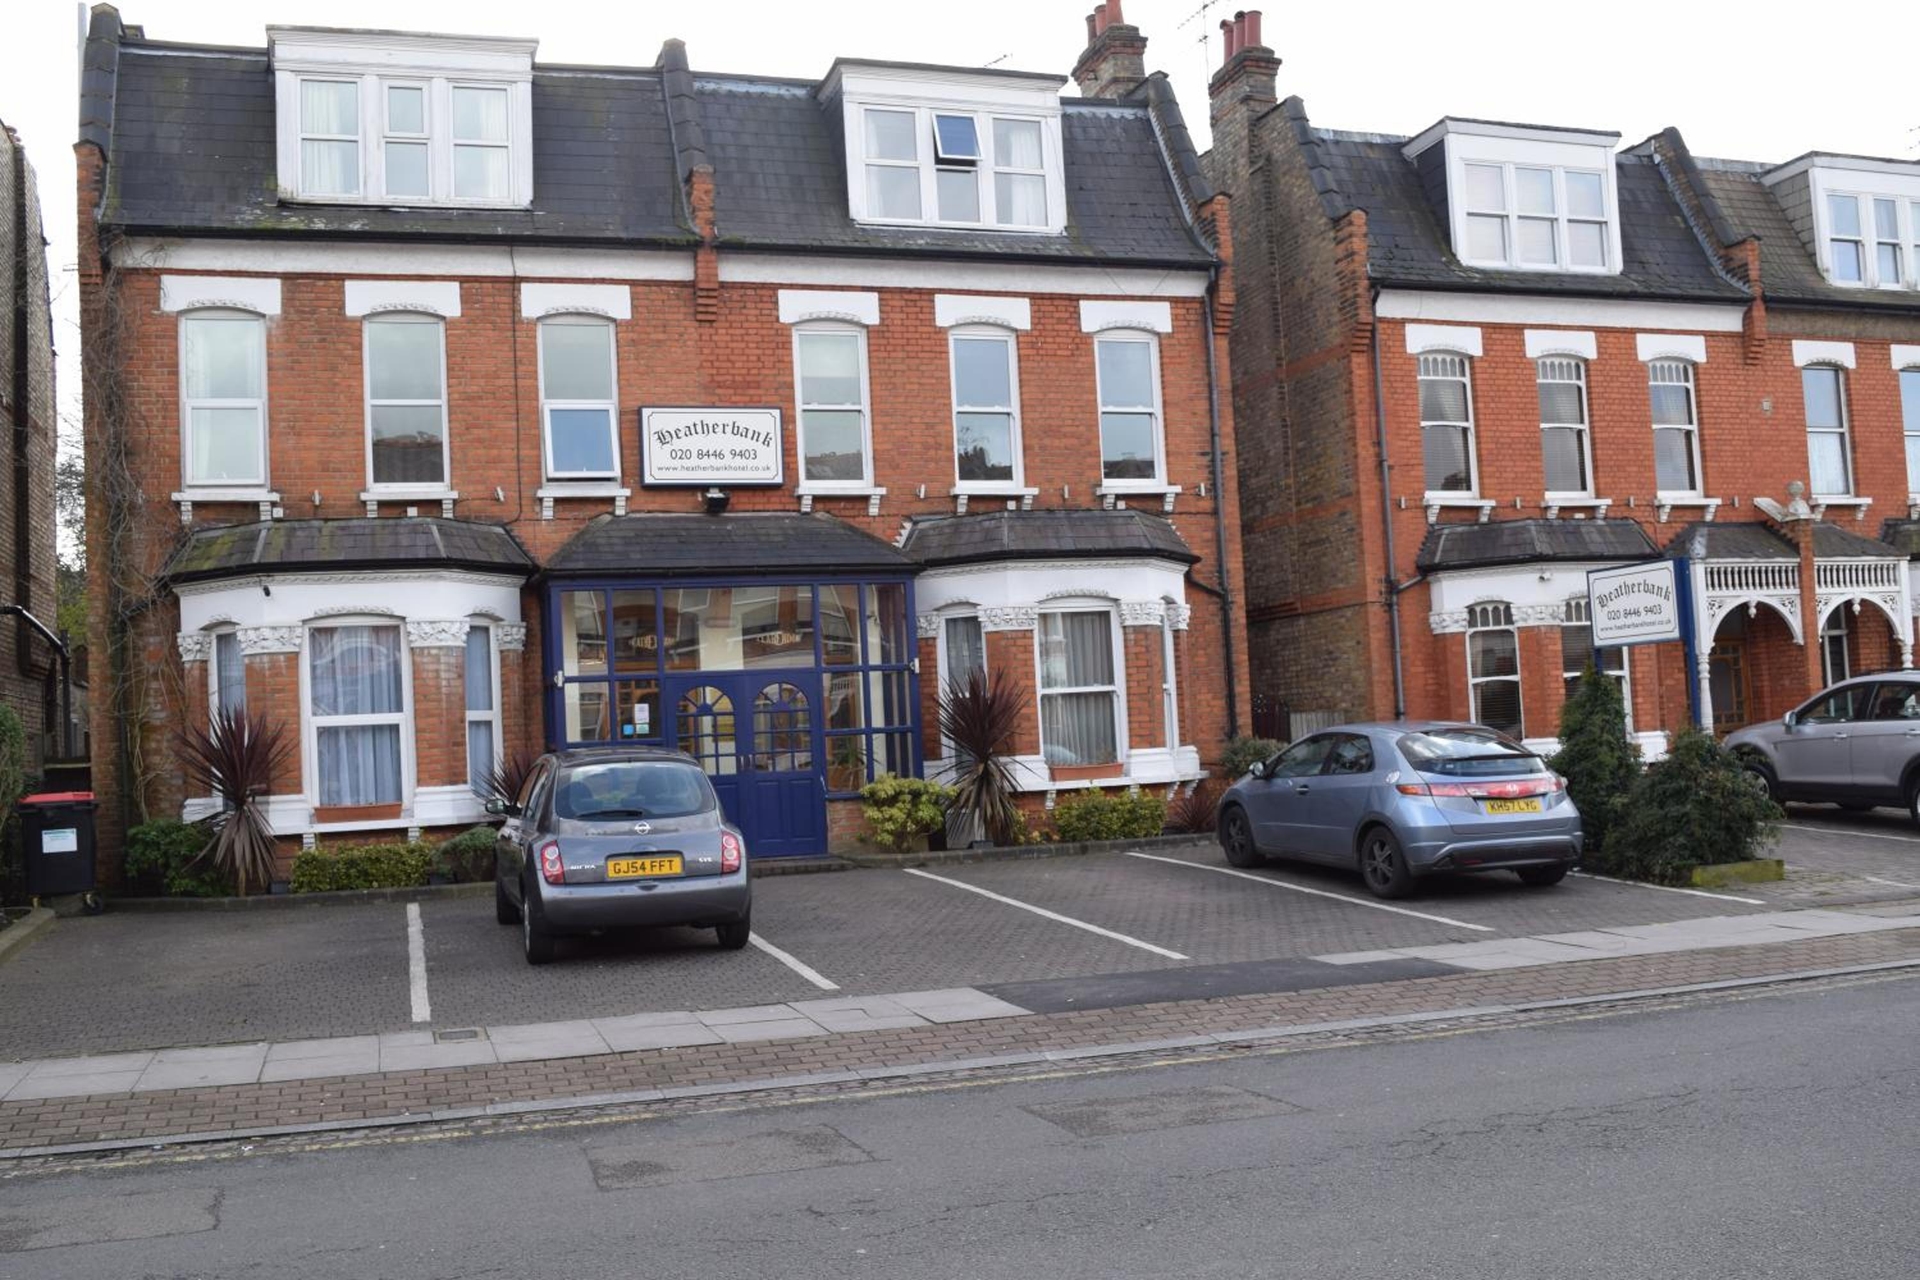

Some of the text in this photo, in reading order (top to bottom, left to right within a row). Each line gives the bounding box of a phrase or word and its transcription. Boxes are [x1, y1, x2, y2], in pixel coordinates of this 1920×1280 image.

[653, 420, 773, 449] Heatherbank
[670, 449, 758, 460] 020 8446 9403
[657, 464, 771, 472] www.heatherbankhotel.co.uk
[1595, 579, 1671, 612] Heatherbank
[1607, 604, 1663, 621] 020 8446 9403
[1489, 800, 1516, 811] KH57
[613, 859, 675, 874] GJ54 FFT
